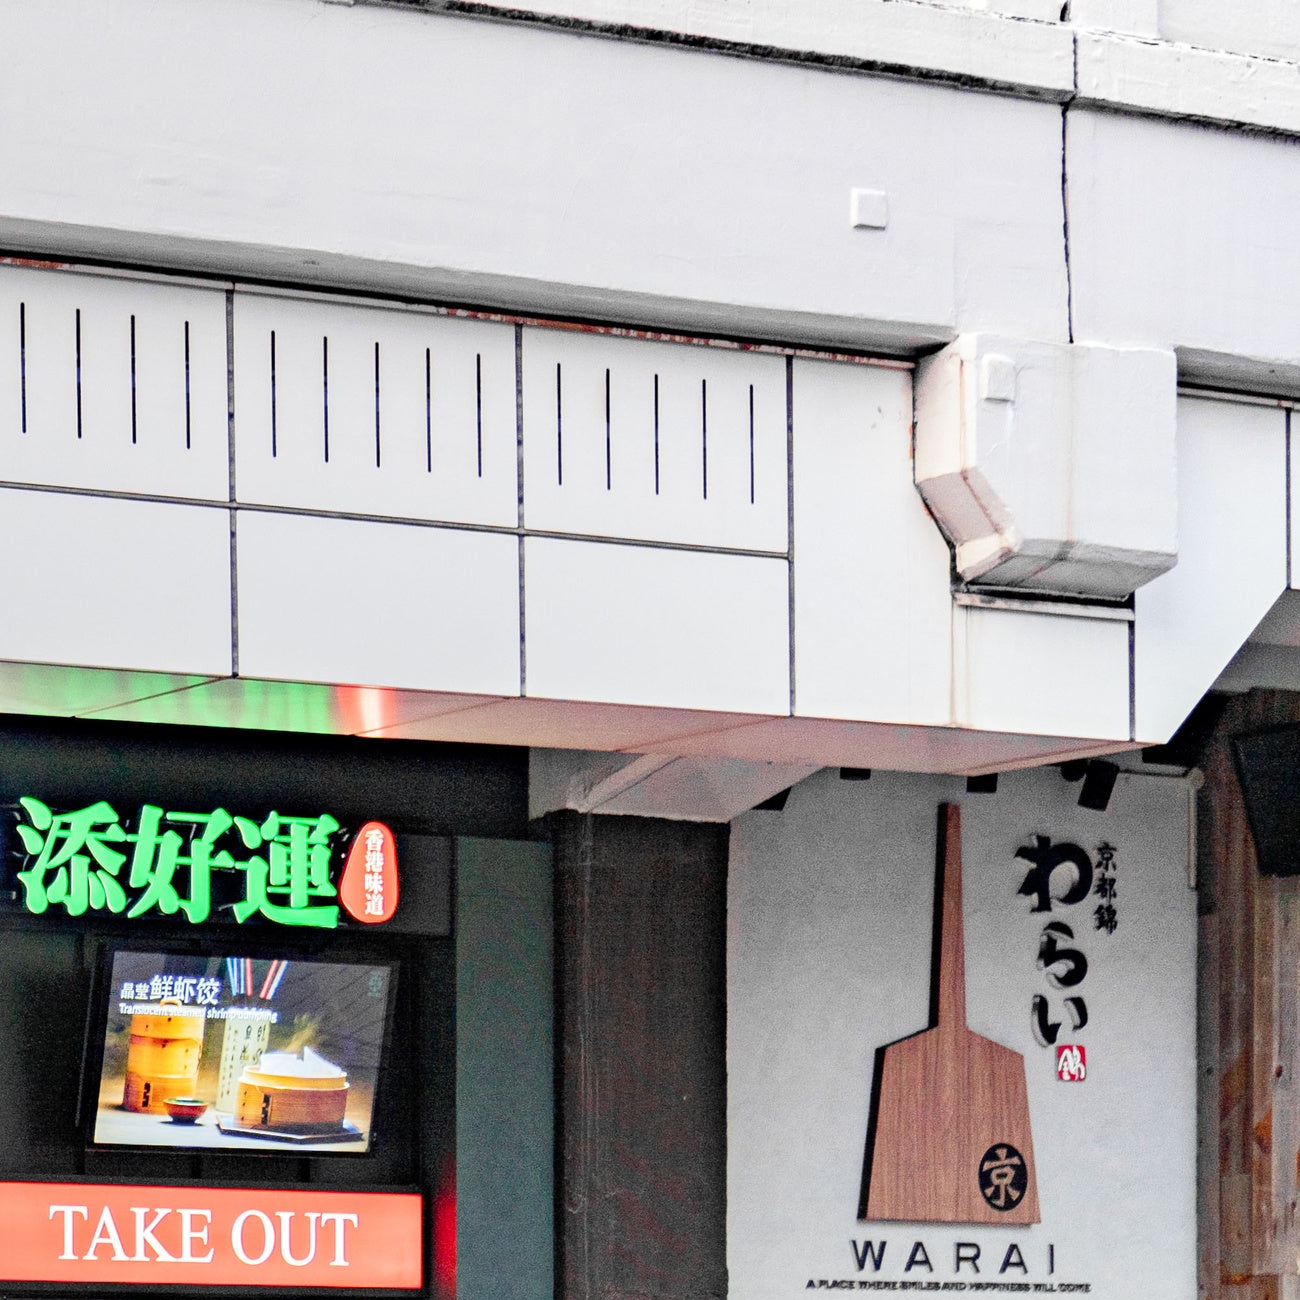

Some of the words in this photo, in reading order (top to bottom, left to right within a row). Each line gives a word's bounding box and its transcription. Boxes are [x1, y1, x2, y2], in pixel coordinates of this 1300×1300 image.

[16, 796, 341, 929] 添好運
[364, 828, 385, 916] 香港味道
[1093, 841, 1119, 936] 京都錦
[1013, 832, 1094, 1048] わらい
[982, 1149, 1025, 1208] 京
[49, 1205, 215, 1263] TAKE
[231, 1209, 358, 1266] OUT
[851, 1239, 1055, 1275] WARAI
[806, 1280, 816, 1289] A
[819, 1280, 856, 1290] PLACE
[858, 1281, 898, 1291] WHERE
[899, 1281, 941, 1291] SMILES
[941, 1282, 967, 1291] AND
[968, 1282, 1031, 1292] HAPPINESS
[1032, 1283, 1057, 1293] WILL
[1057, 1283, 1092, 1293] COME
